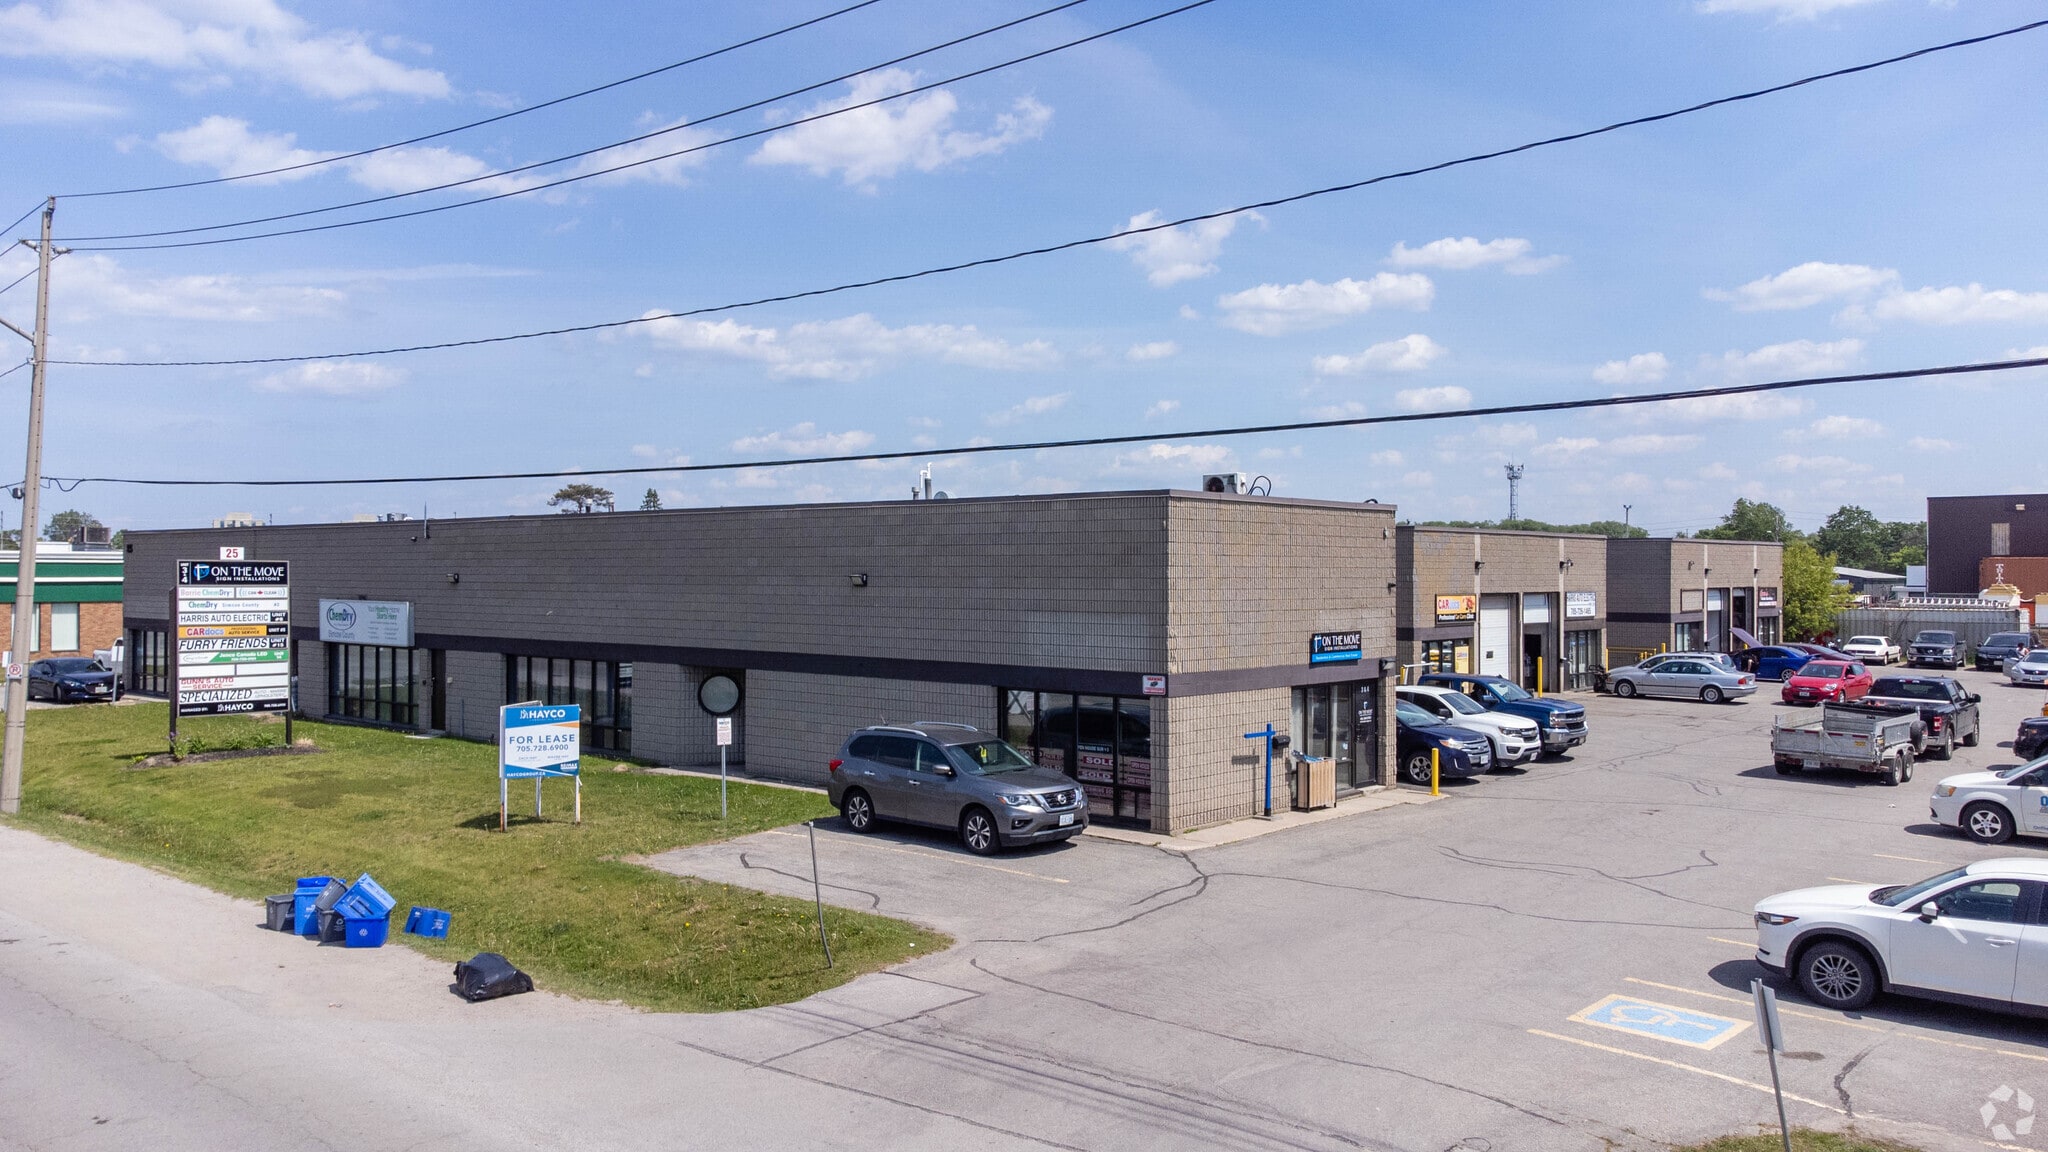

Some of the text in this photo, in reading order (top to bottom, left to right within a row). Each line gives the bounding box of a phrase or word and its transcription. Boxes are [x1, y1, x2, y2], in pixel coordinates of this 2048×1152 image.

[226, 549, 238, 558] 25
[211, 566, 285, 576] ON THE MOVE
[202, 589, 230, 597] ChemDry
[188, 601, 218, 609] ChemDry
[180, 615, 209, 623] HARRIS
[210, 614, 232, 622] AUTO
[234, 613, 269, 622] ELECTRIC
[187, 627, 225, 636] CARdocs
[179, 640, 217, 650] FURRY
[220, 638, 268, 649] FRIENDS
[1322, 634, 1360, 646] ON THE MOVE
[180, 689, 253, 703] SPECIALIZED
[225, 703, 254, 711] HAYCO
[529, 709, 566, 719] HAYCO
[509, 734, 576, 744] FOR LEASE
[516, 744, 569, 752] 705.728.6900
